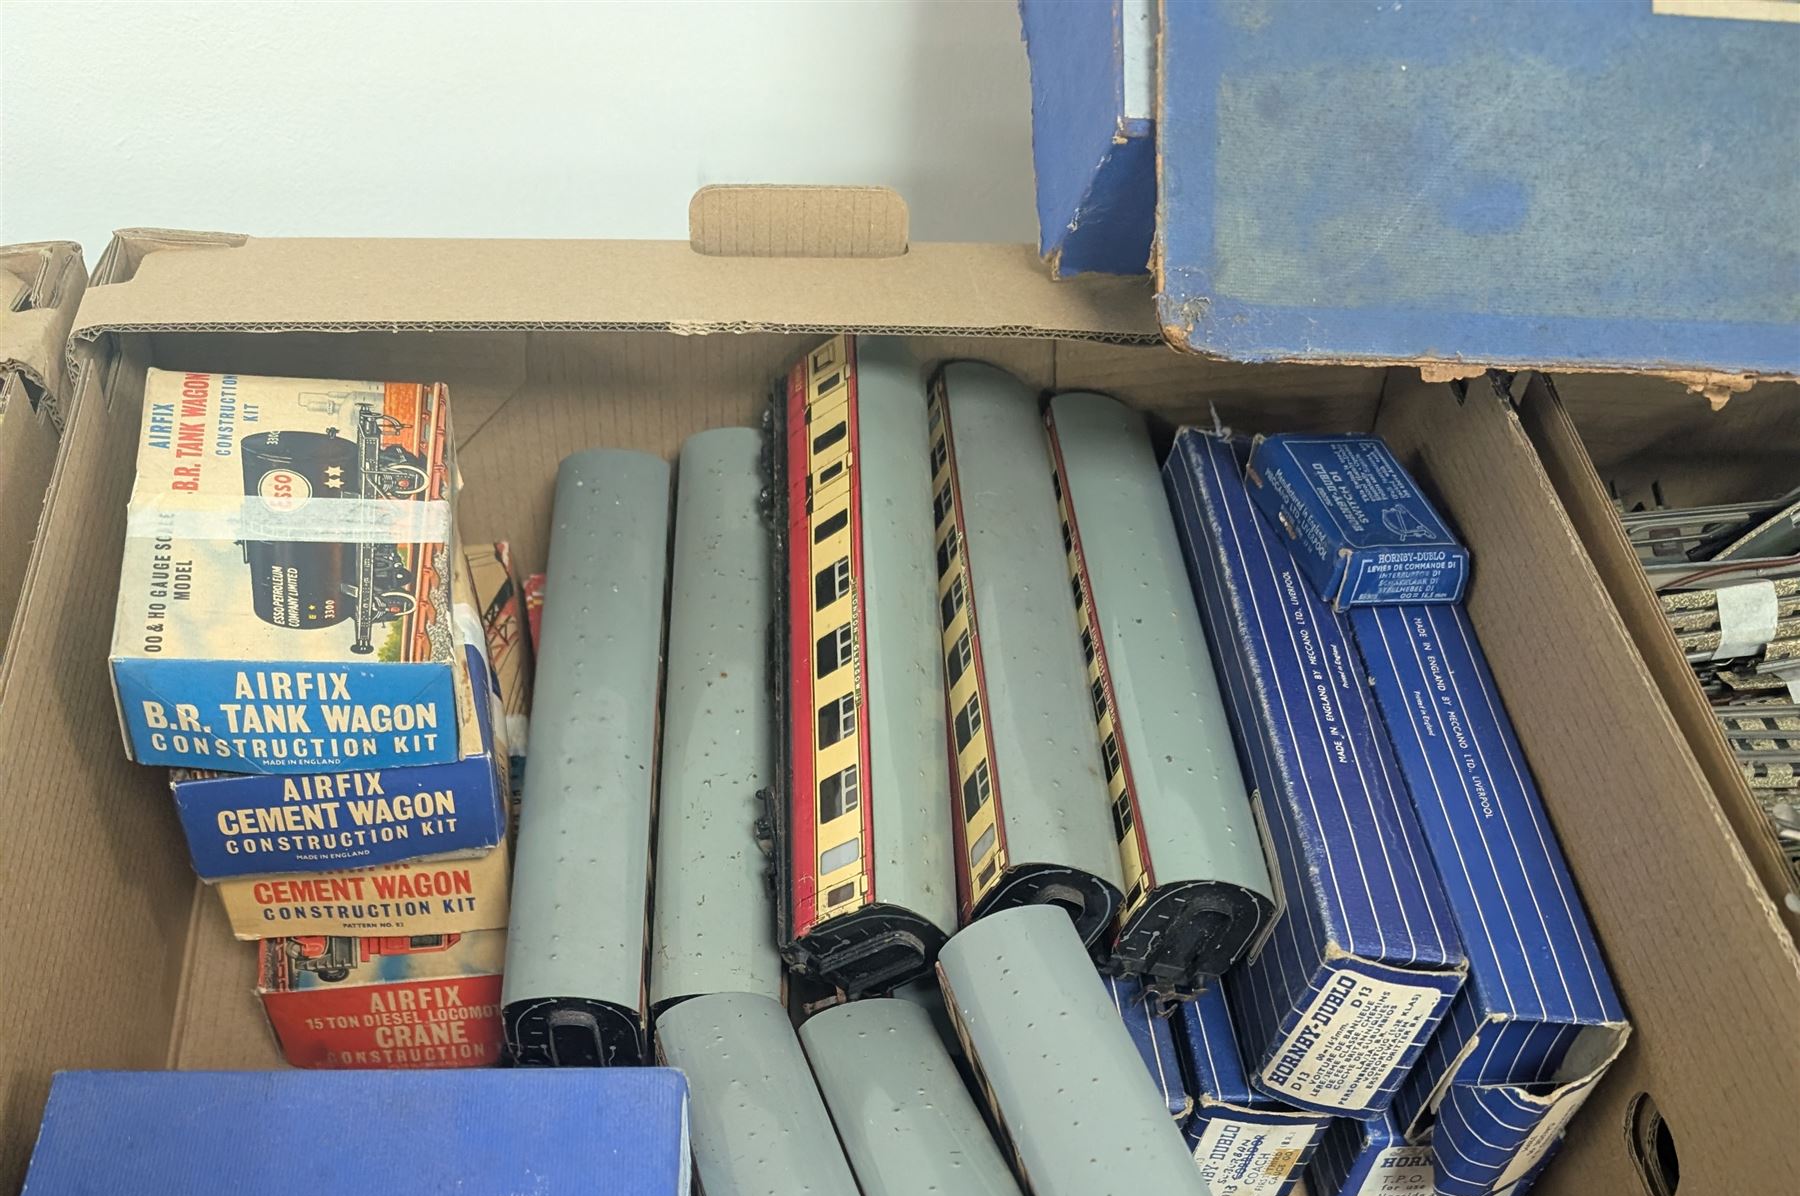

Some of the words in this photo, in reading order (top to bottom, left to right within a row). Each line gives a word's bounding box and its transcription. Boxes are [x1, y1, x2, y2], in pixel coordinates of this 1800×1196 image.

[181, 372, 210, 417] WAGON
[148, 404, 175, 449] AIRFIX
[215, 374, 238, 456] CONSTRUCTION
[243, 404, 259, 421] KIT
[176, 422, 206, 457] TANK
[1339, 485, 1370, 525] SWITCH
[1378, 551, 1446, 564] HORNBY-DUBLO
[1404, 562, 1445, 570] COMMANDE
[150, 555, 171, 597] GAUGE
[173, 560, 193, 600] MODEL
[272, 566, 284, 606] PETROLEUM
[287, 568, 298, 592] LIMITED
[1282, 571, 1298, 605] LIVERPOOL
[148, 603, 166, 619] HO
[273, 607, 285, 625] ESSO
[288, 593, 300, 627] COMPANY
[324, 600, 335, 619] 3300
[146, 623, 164, 632] &
[1300, 630, 1318, 665] MECCANO
[234, 671, 352, 701] AIRFIX
[1312, 670, 1322, 680] BY
[142, 700, 212, 734] B.R.
[220, 703, 312, 734] TANK
[321, 702, 437, 733] WAGON
[1317, 684, 1334, 722] ENGLAND
[1413, 617, 1427, 637] MADE
[1422, 642, 1431, 651] IN
[1427, 655, 1446, 692] ENGLAND
[1441, 696, 1451, 706] BY
[1447, 711, 1468, 749] MECCANO
[1472, 776, 1493, 819] LIVERPOOL
[1329, 726, 1338, 736] IN
[1423, 715, 1435, 736] England
[151, 733, 377, 760] CONSTRUCTION
[394, 733, 438, 754] KIT
[298, 758, 341, 766] ENGLAND
[1334, 737, 1347, 763] MADE
[283, 772, 384, 802] AIRFIX
[217, 802, 340, 836] CEMENT
[349, 790, 456, 826] WAGON
[225, 826, 409, 855] CONSTRUCTION
[422, 818, 458, 836] KIT
[329, 850, 370, 859] ENGLAND
[253, 877, 365, 906] CEMENT
[373, 870, 473, 900] WAGON
[263, 901, 431, 921] CONSTRUCTION
[443, 898, 477, 913] KIT
[370, 986, 462, 1014] AIRFIX
[1361, 989, 1391, 1028] CHEMINS
[305, 1018, 324, 1031] 15
[327, 1015, 360, 1030] TON
[364, 1011, 420, 1027] DIESEL
[375, 1021, 469, 1050] CRANE
[1268, 975, 1358, 1087] HORNBY-DUBLO
[326, 1043, 486, 1065] CONSTRUCTION
[1309, 1052, 1337, 1087] VOITURE
[1334, 1040, 1346, 1053] DE
[1343, 1000, 1375, 1040] BANLIEUE
[1325, 1078, 1336, 1089] DE
[1334, 1063, 1347, 1078] FER
[1344, 1002, 1390, 1064] BRITANNIQUES
[1333, 1062, 1356, 1091] COCHE
[1353, 1050, 1364, 1062] DE
[1362, 1003, 1398, 1050] SUBURBIOS
[1244, 1152, 1271, 1185] COACH
[1383, 1175, 1425, 1184] T.P.O.
